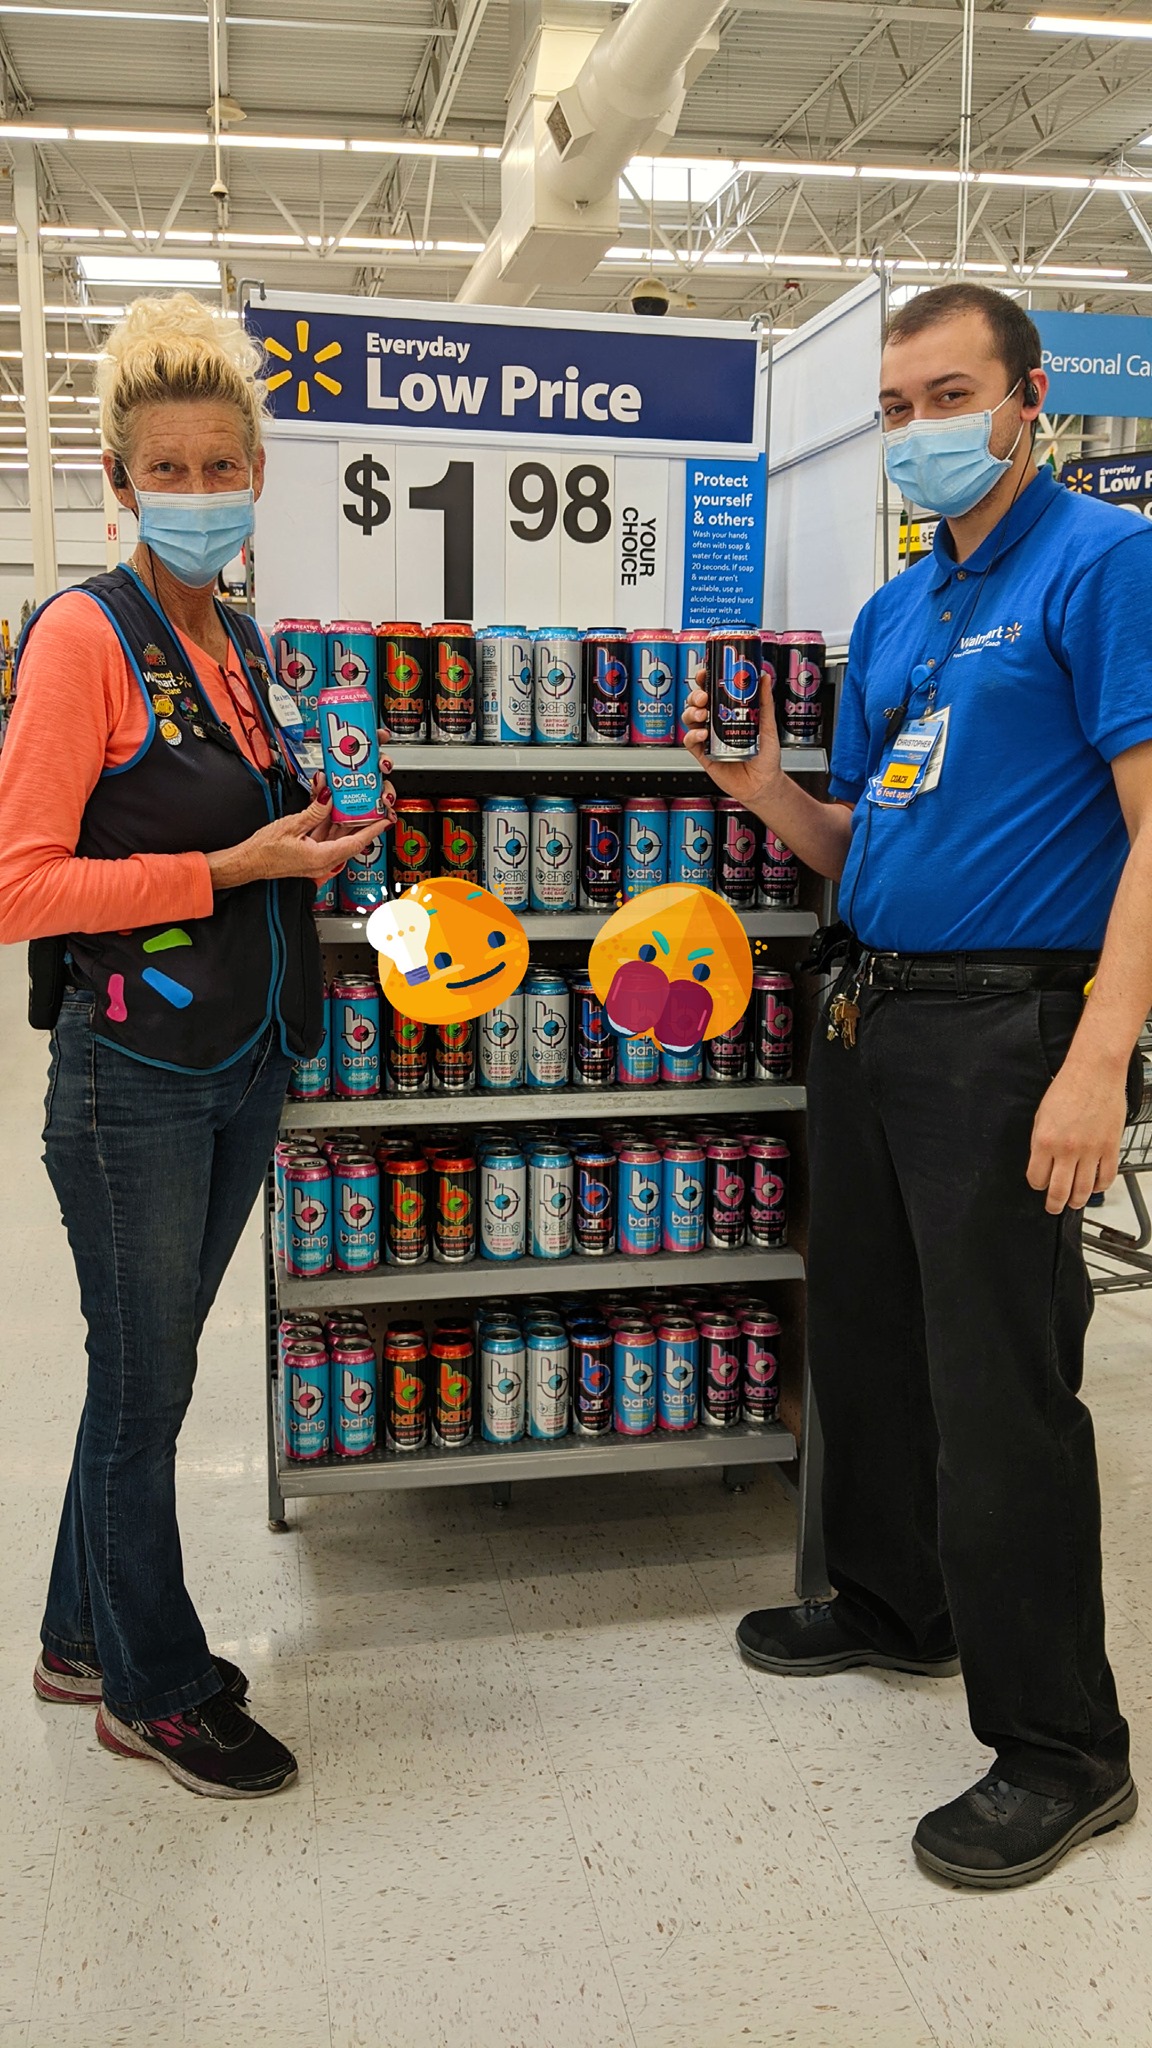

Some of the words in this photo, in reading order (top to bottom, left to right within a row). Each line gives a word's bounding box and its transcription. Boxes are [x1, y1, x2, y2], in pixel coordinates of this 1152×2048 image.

[366, 332, 471, 364] Everyday
[1041, 350, 1120, 375] Personal
[366, 357, 489, 415] Low
[501, 365, 642, 423] Price
[1100, 464, 1136, 476] Everyday
[694, 472, 748, 488] Protect
[1099, 475, 1142, 494] Low
[693, 493, 753, 509] yourself
[693, 511, 705, 525] &
[708, 511, 754, 527] others
[692, 530, 711, 538] Wash
[712, 532, 728, 540] your
[728, 531, 748, 540] hands
[620, 506, 639, 587] CHOICE
[640, 517, 657, 578] YOUR
[692, 541, 711, 549] often
[712, 542, 727, 550] with
[728, 543, 744, 551] soap
[745, 543, 751, 551] &
[692, 552, 711, 560] water
[712, 552, 723, 560] for
[731, 553, 748, 561] least
[691, 562, 701, 570] 20
[702, 563, 731, 571] seconds.
[738, 565, 755, 573] soap
[718, 574, 739, 582] aren't
[690, 585, 721, 593] available,
[690, 596, 736, 604] alcohol-based
[737, 596, 754, 604] hand
[689, 606, 718, 614] sanitizer
[718, 606, 733, 614] with
[734, 607, 741, 615] at
[689, 616, 705, 624] least
[706, 617, 721, 625] 60%
[960, 625, 1004, 650] Walmart
[537, 697, 577, 717] bang
[637, 699, 674, 718] bang
[896, 738, 932, 748] CHRISTOPHER
[331, 771, 377, 790] bang
[890, 774, 909, 784] COACH
[343, 792, 368, 800] RADICAL
[883, 788, 896, 798] feet
[896, 791, 913, 800] apart
[346, 866, 385, 885] bang
[535, 867, 574, 886] bang
[626, 867, 663, 883] bang
[341, 1053, 378, 1069] bang
[484, 1218, 521, 1235] bang
[628, 1213, 660, 1228] bang
[671, 1211, 704, 1226] bang
[291, 1233, 329, 1249] bang
[340, 1229, 376, 1245] bang
[662, 1391, 696, 1405] bang
[289, 1418, 326, 1434] bang
[340, 1414, 375, 1429] bang
